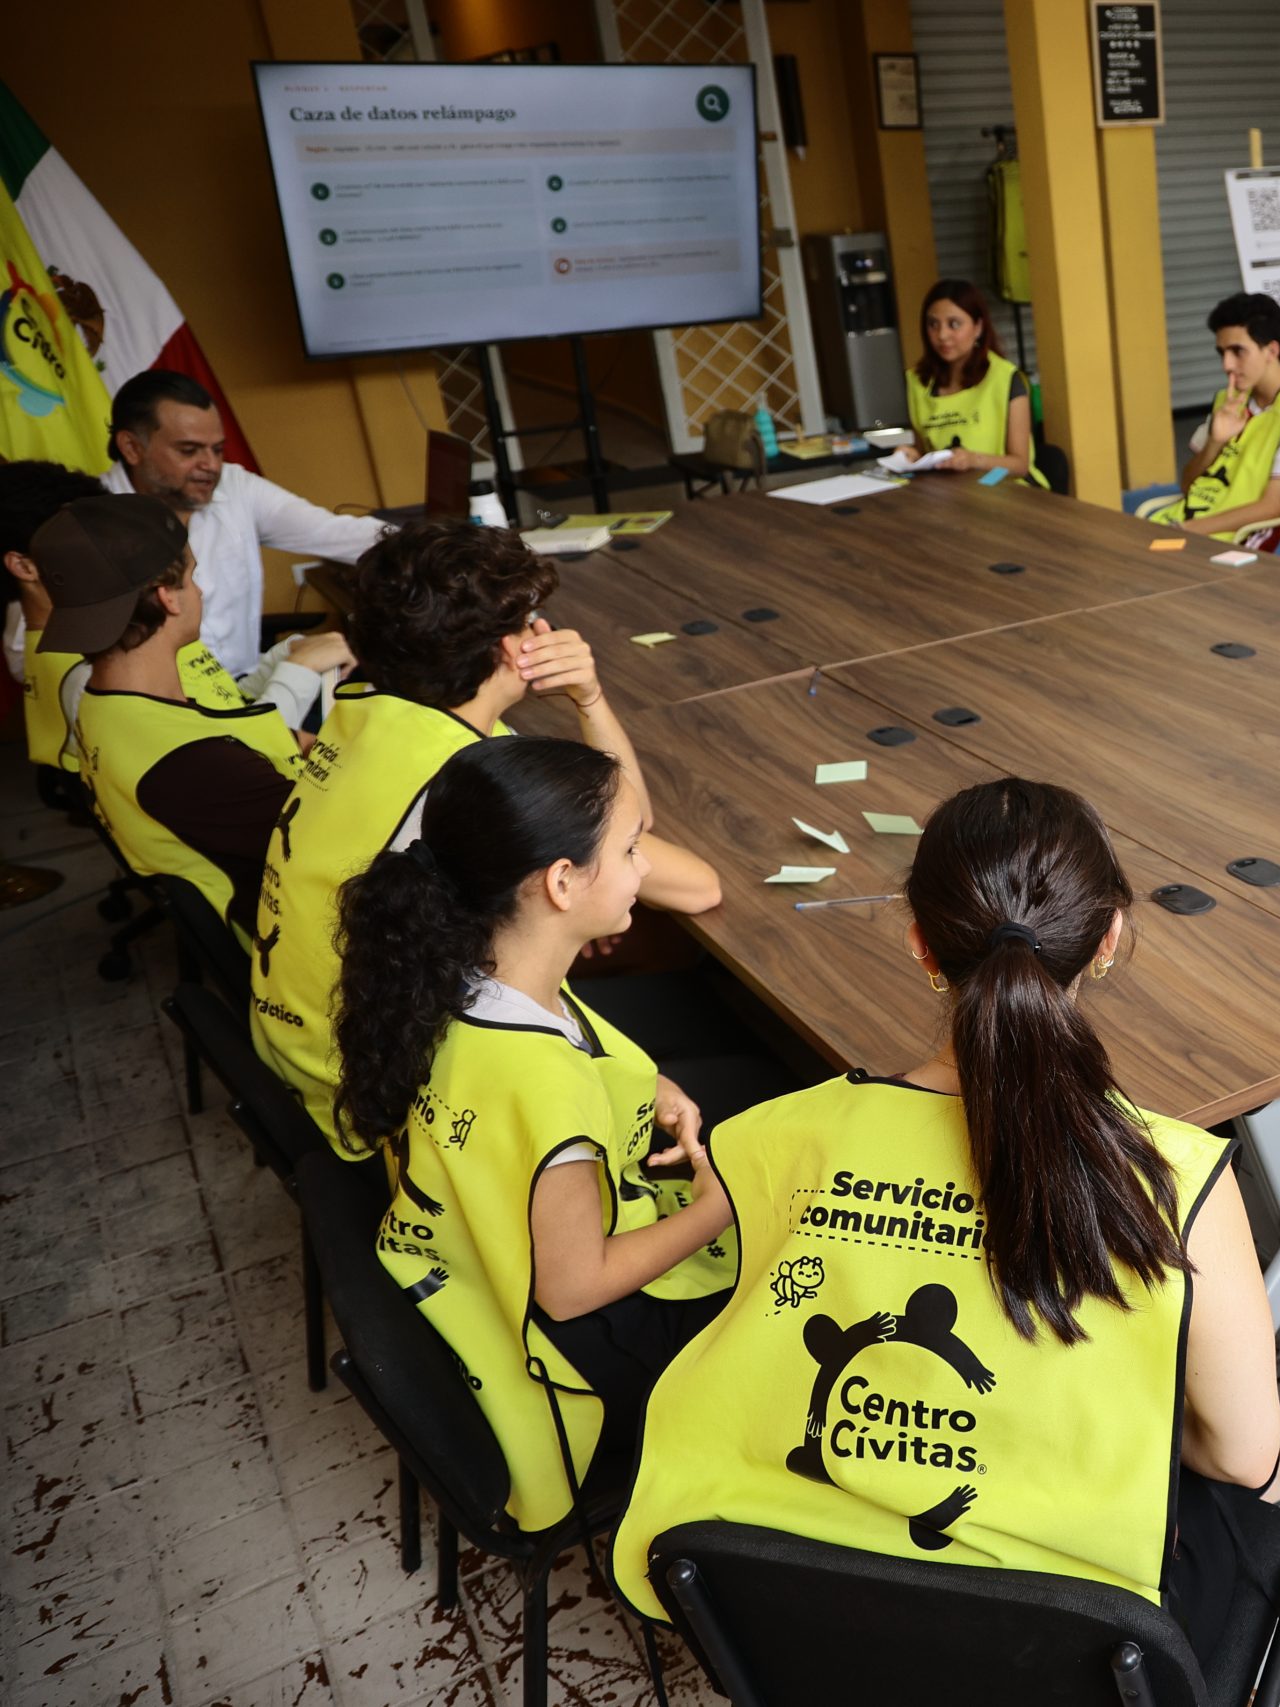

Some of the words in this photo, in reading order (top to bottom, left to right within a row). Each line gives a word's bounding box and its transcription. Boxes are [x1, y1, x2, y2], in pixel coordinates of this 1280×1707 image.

[289, 107, 335, 121] Caza
[340, 105, 363, 121] de
[367, 105, 417, 121] datos
[422, 104, 516, 123] relámpago
[830, 1170, 975, 1214] Servicio
[800, 1205, 986, 1250] comunitari
[840, 1375, 977, 1433] Centro
